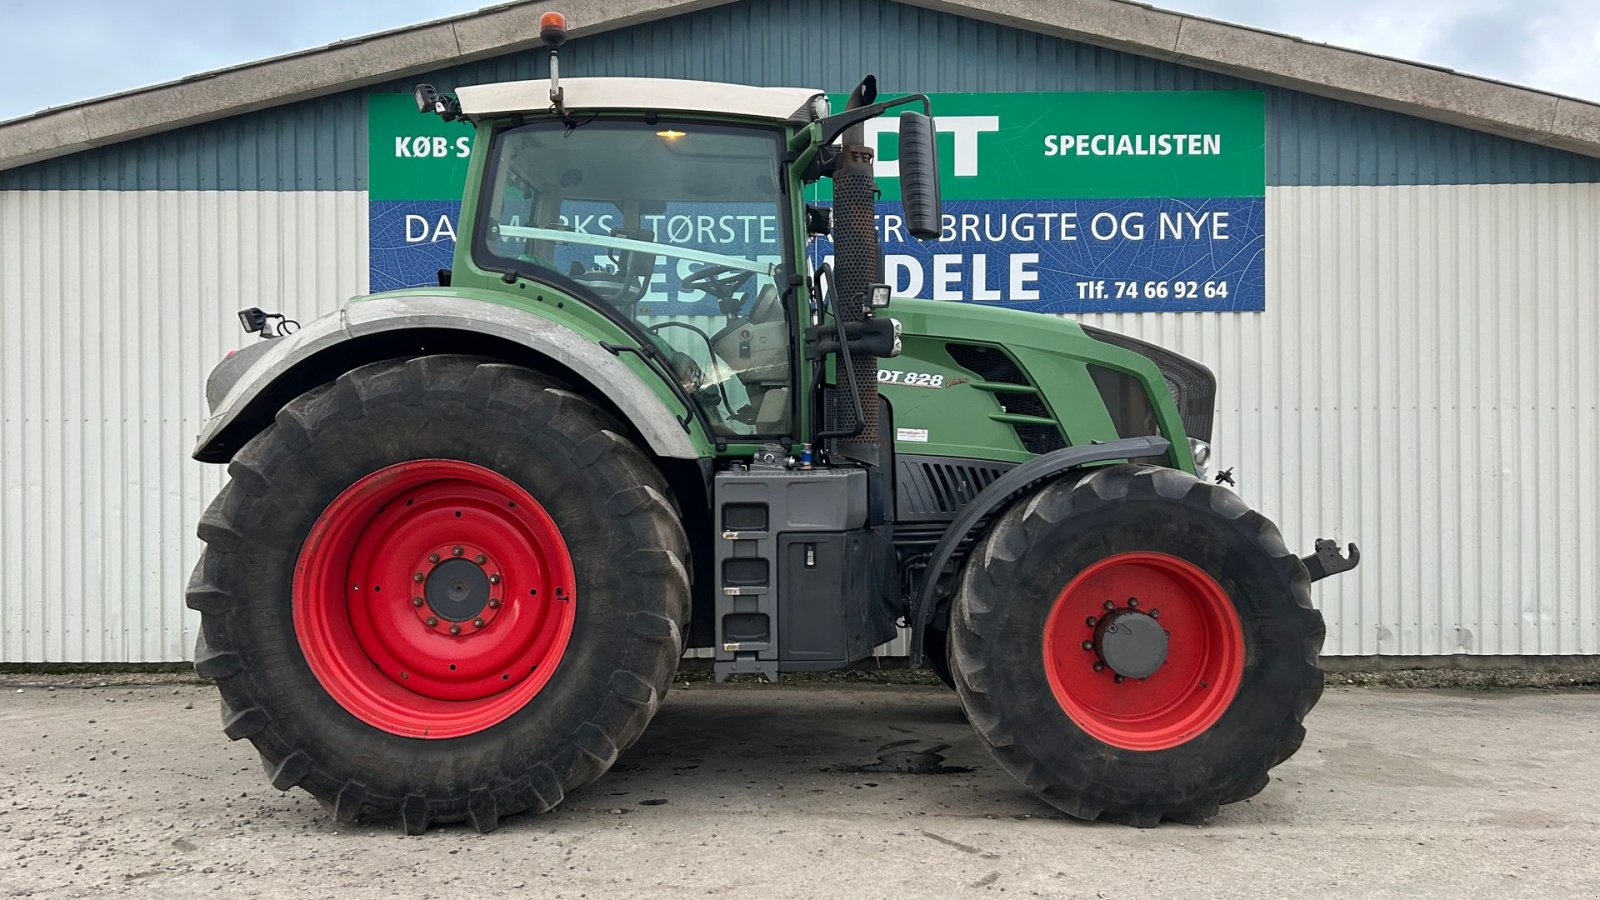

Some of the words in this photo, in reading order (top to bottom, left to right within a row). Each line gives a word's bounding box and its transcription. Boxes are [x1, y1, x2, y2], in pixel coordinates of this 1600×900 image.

[1044, 134, 1221, 156] SPECIALISTEN
[645, 213, 776, 243] TØRSTE
[939, 212, 1078, 242] BRUGTE
[1091, 212, 1144, 241] OG
[1160, 212, 1229, 241] NYE
[1076, 281, 1109, 299] Tlf.
[1114, 281, 1139, 299] 74
[1144, 281, 1169, 299] 66
[1174, 281, 1199, 299] 92
[1204, 281, 1229, 299] 64
[904, 372, 944, 387] 828
